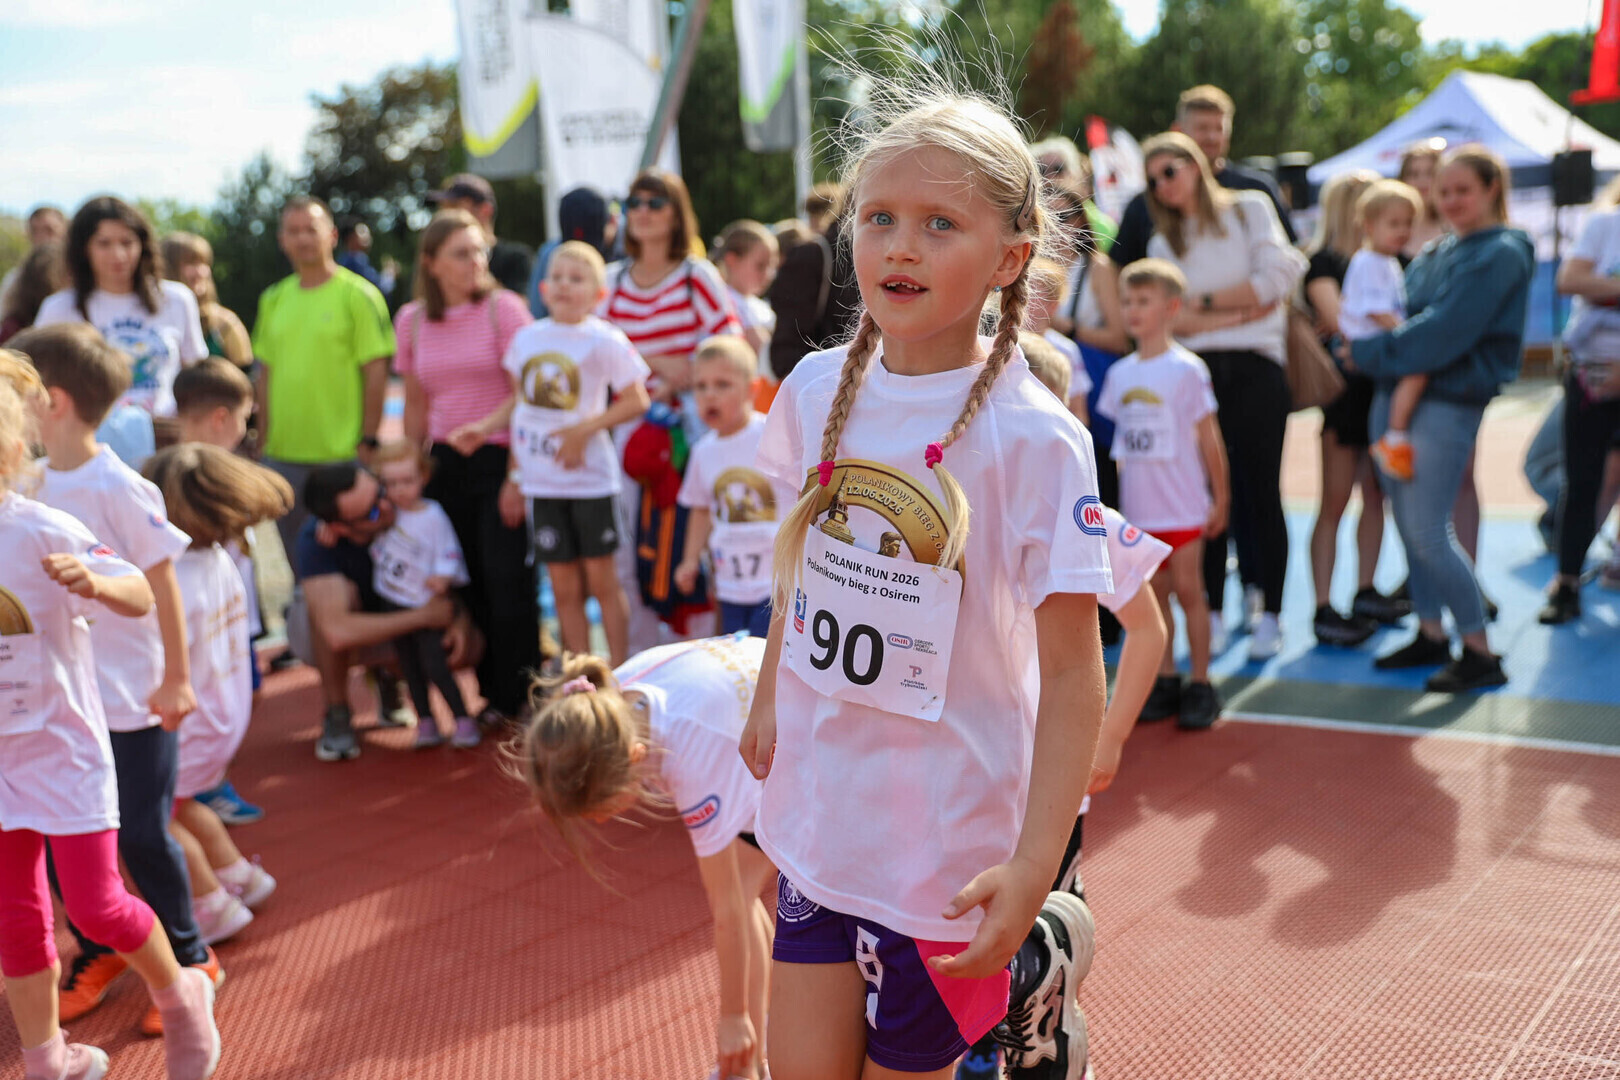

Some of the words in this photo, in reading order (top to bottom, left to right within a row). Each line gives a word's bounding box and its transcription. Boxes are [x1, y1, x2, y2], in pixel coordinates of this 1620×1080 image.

[847, 485, 904, 516] 12.06.2026
[850, 473, 915, 507] POLANIKOWY
[912, 504, 935, 531] BIEG
[929, 531, 940, 541] Z
[730, 553, 762, 579] 17
[807, 557, 847, 587] Polanikowy
[848, 576, 870, 594] bieg
[871, 586, 877, 594] z
[879, 587, 921, 604] Osirem
[824, 550, 863, 574] POLANIK
[864, 567, 889, 580] RUN
[891, 572, 920, 587] 2026
[809, 608, 884, 686] 90
